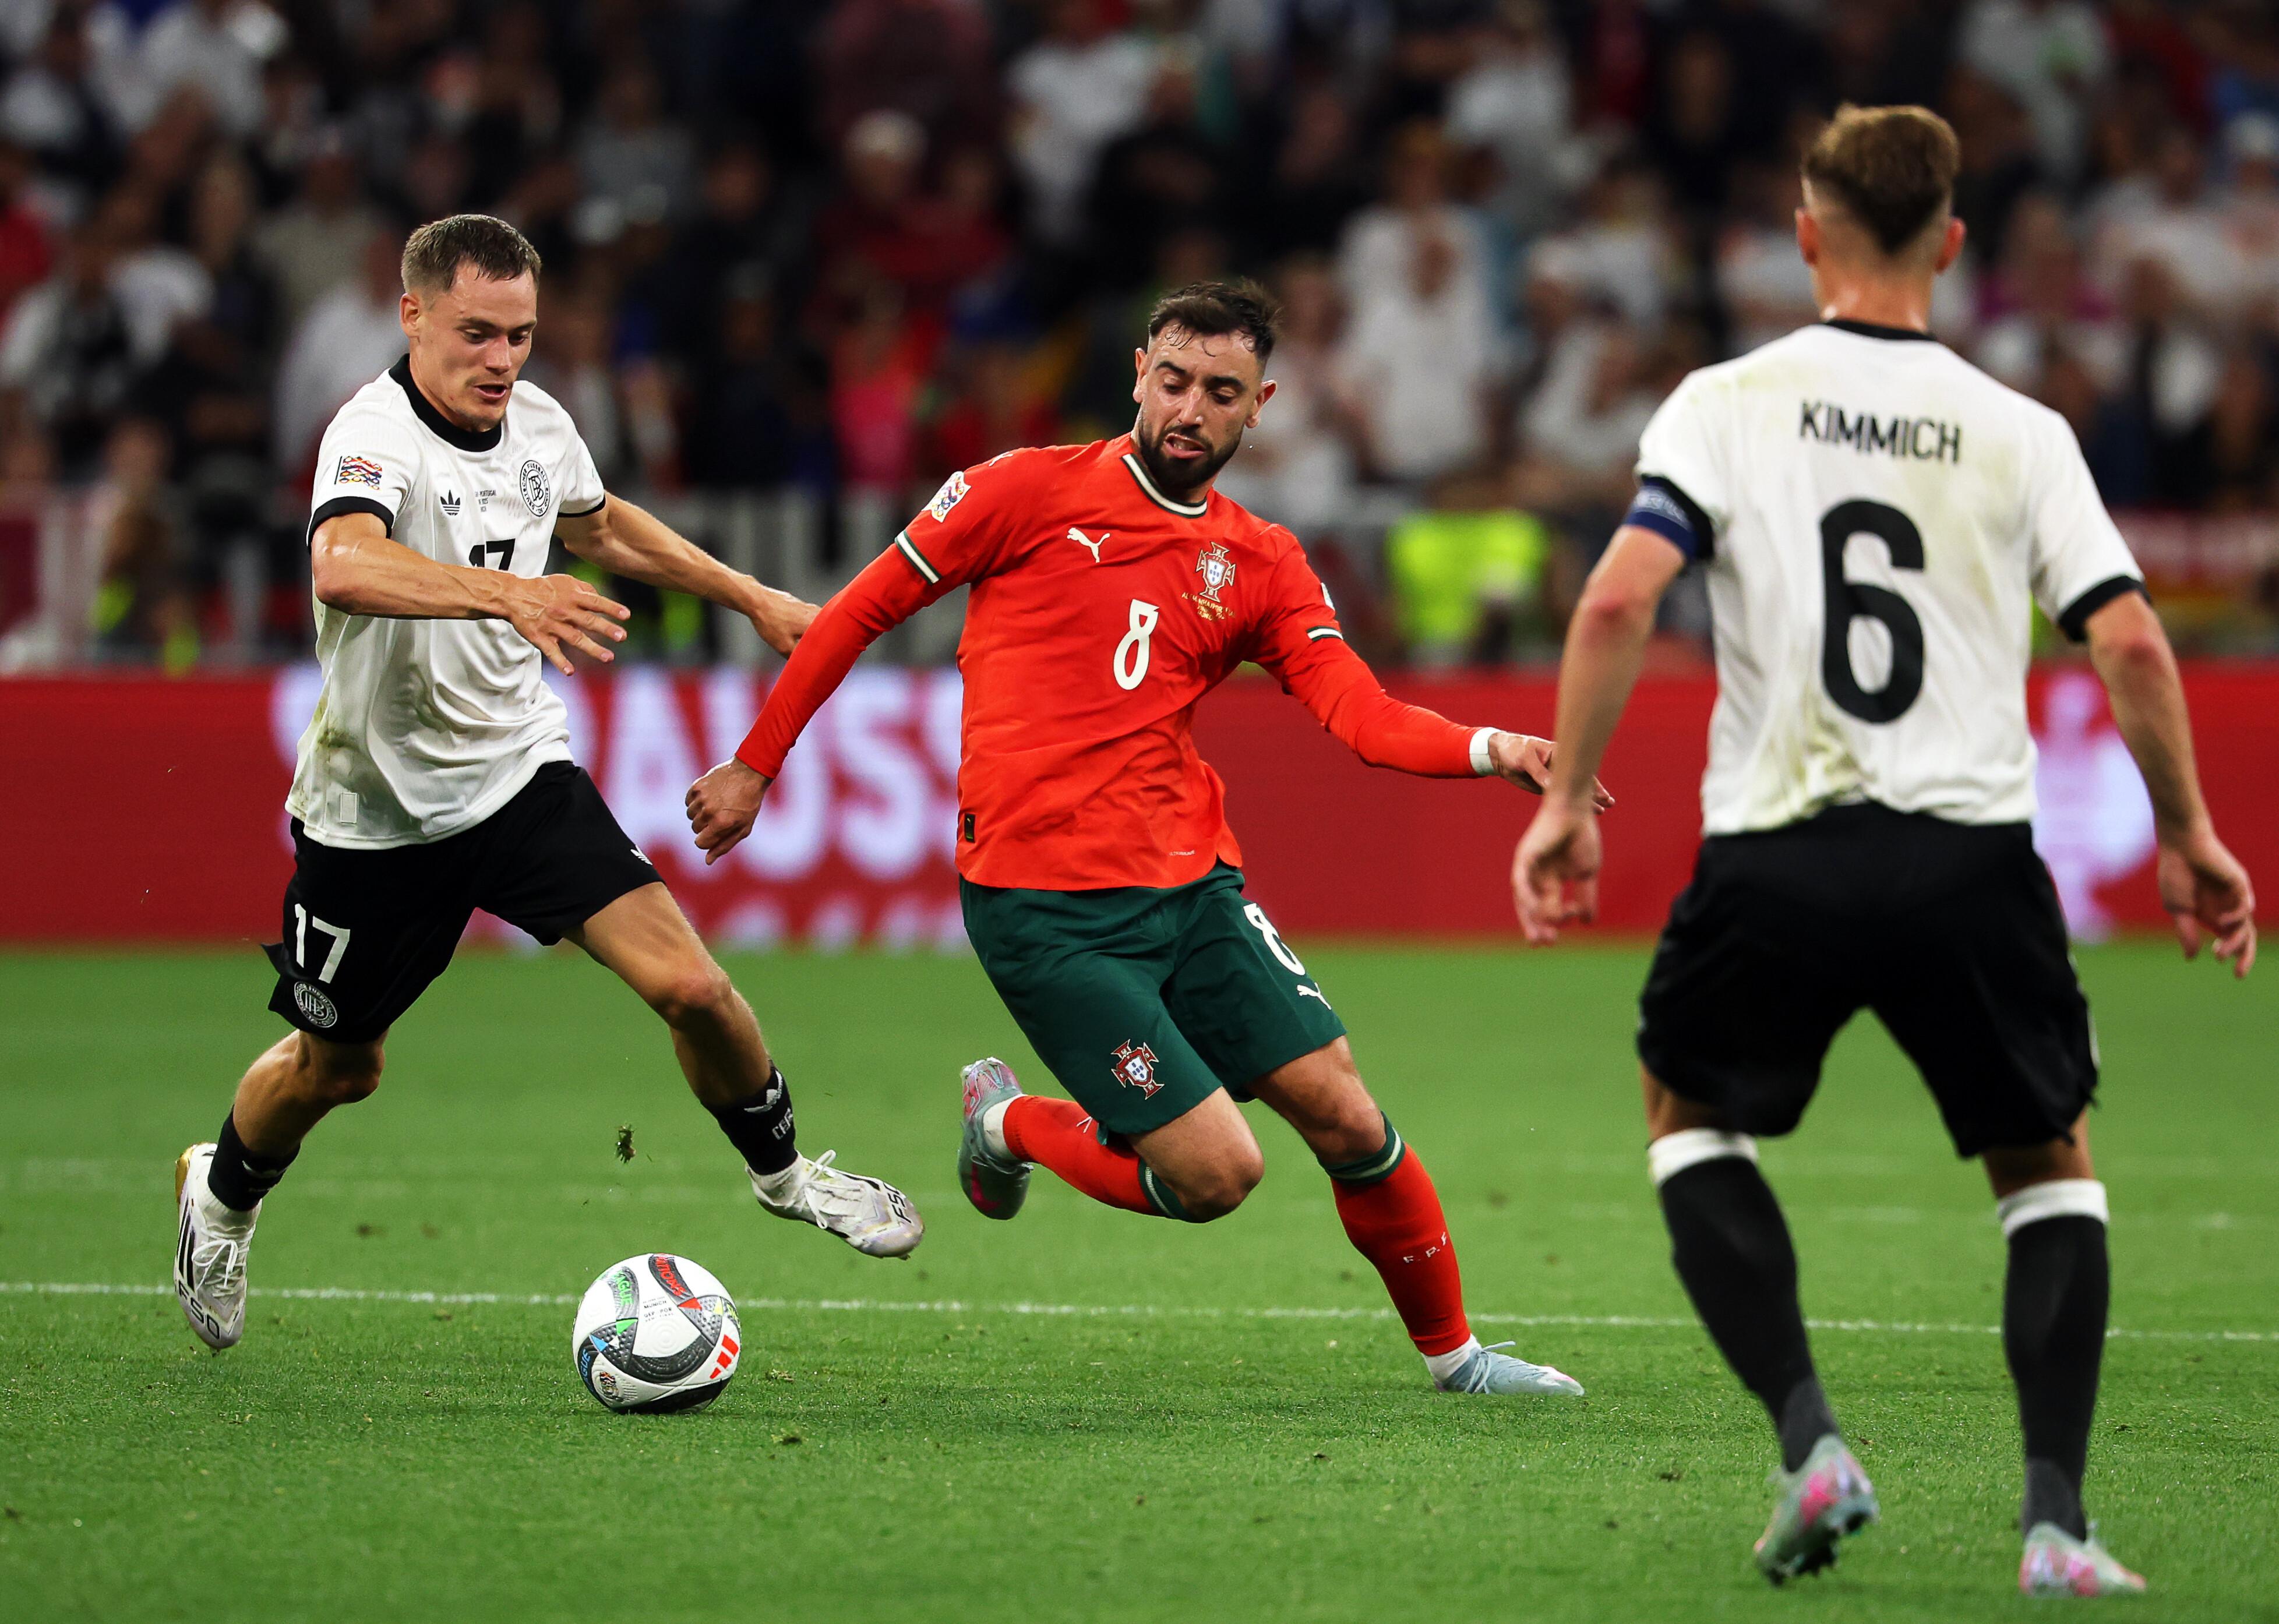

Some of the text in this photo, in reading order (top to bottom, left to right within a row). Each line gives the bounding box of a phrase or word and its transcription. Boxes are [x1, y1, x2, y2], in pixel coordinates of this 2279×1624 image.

[1800, 401, 1962, 464] KIMMICH
[468, 538, 516, 571] 17
[1113, 598, 1160, 690] 8
[1819, 497, 1925, 725] 6
[294, 903, 351, 984] 17
[1243, 902, 1306, 976] 8
[178, 1279, 220, 1340] F50
